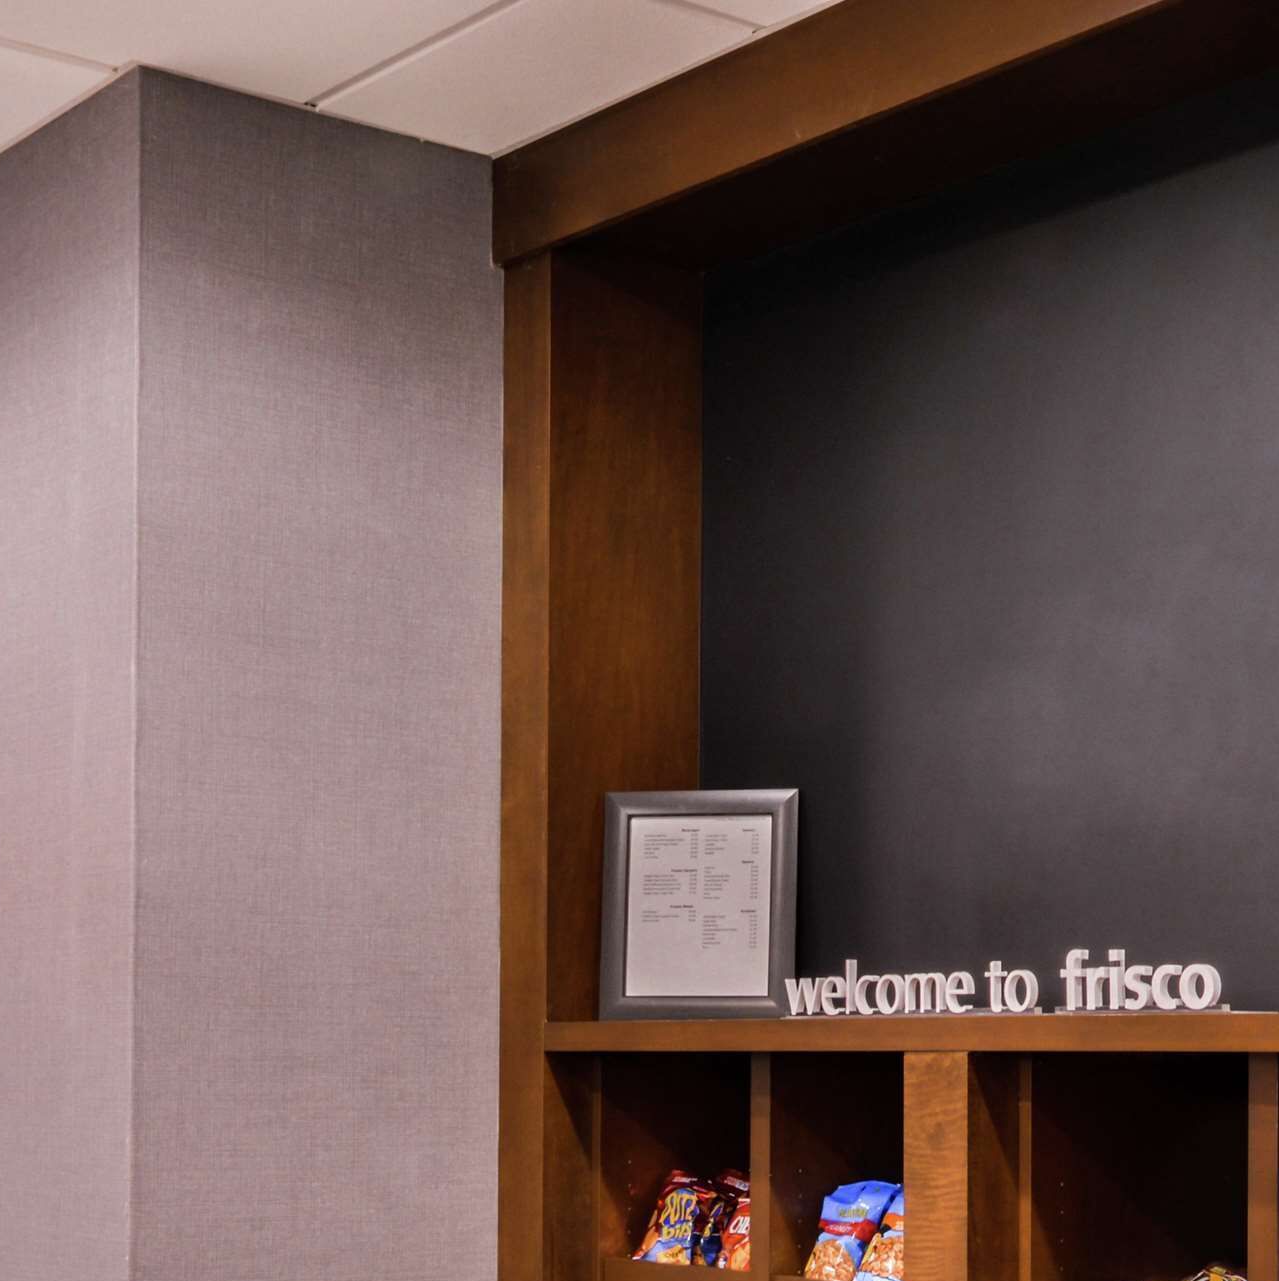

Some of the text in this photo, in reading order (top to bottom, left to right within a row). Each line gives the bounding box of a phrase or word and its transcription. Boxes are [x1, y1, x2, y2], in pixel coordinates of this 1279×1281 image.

[785, 949, 1223, 1015] welcome to frisco
